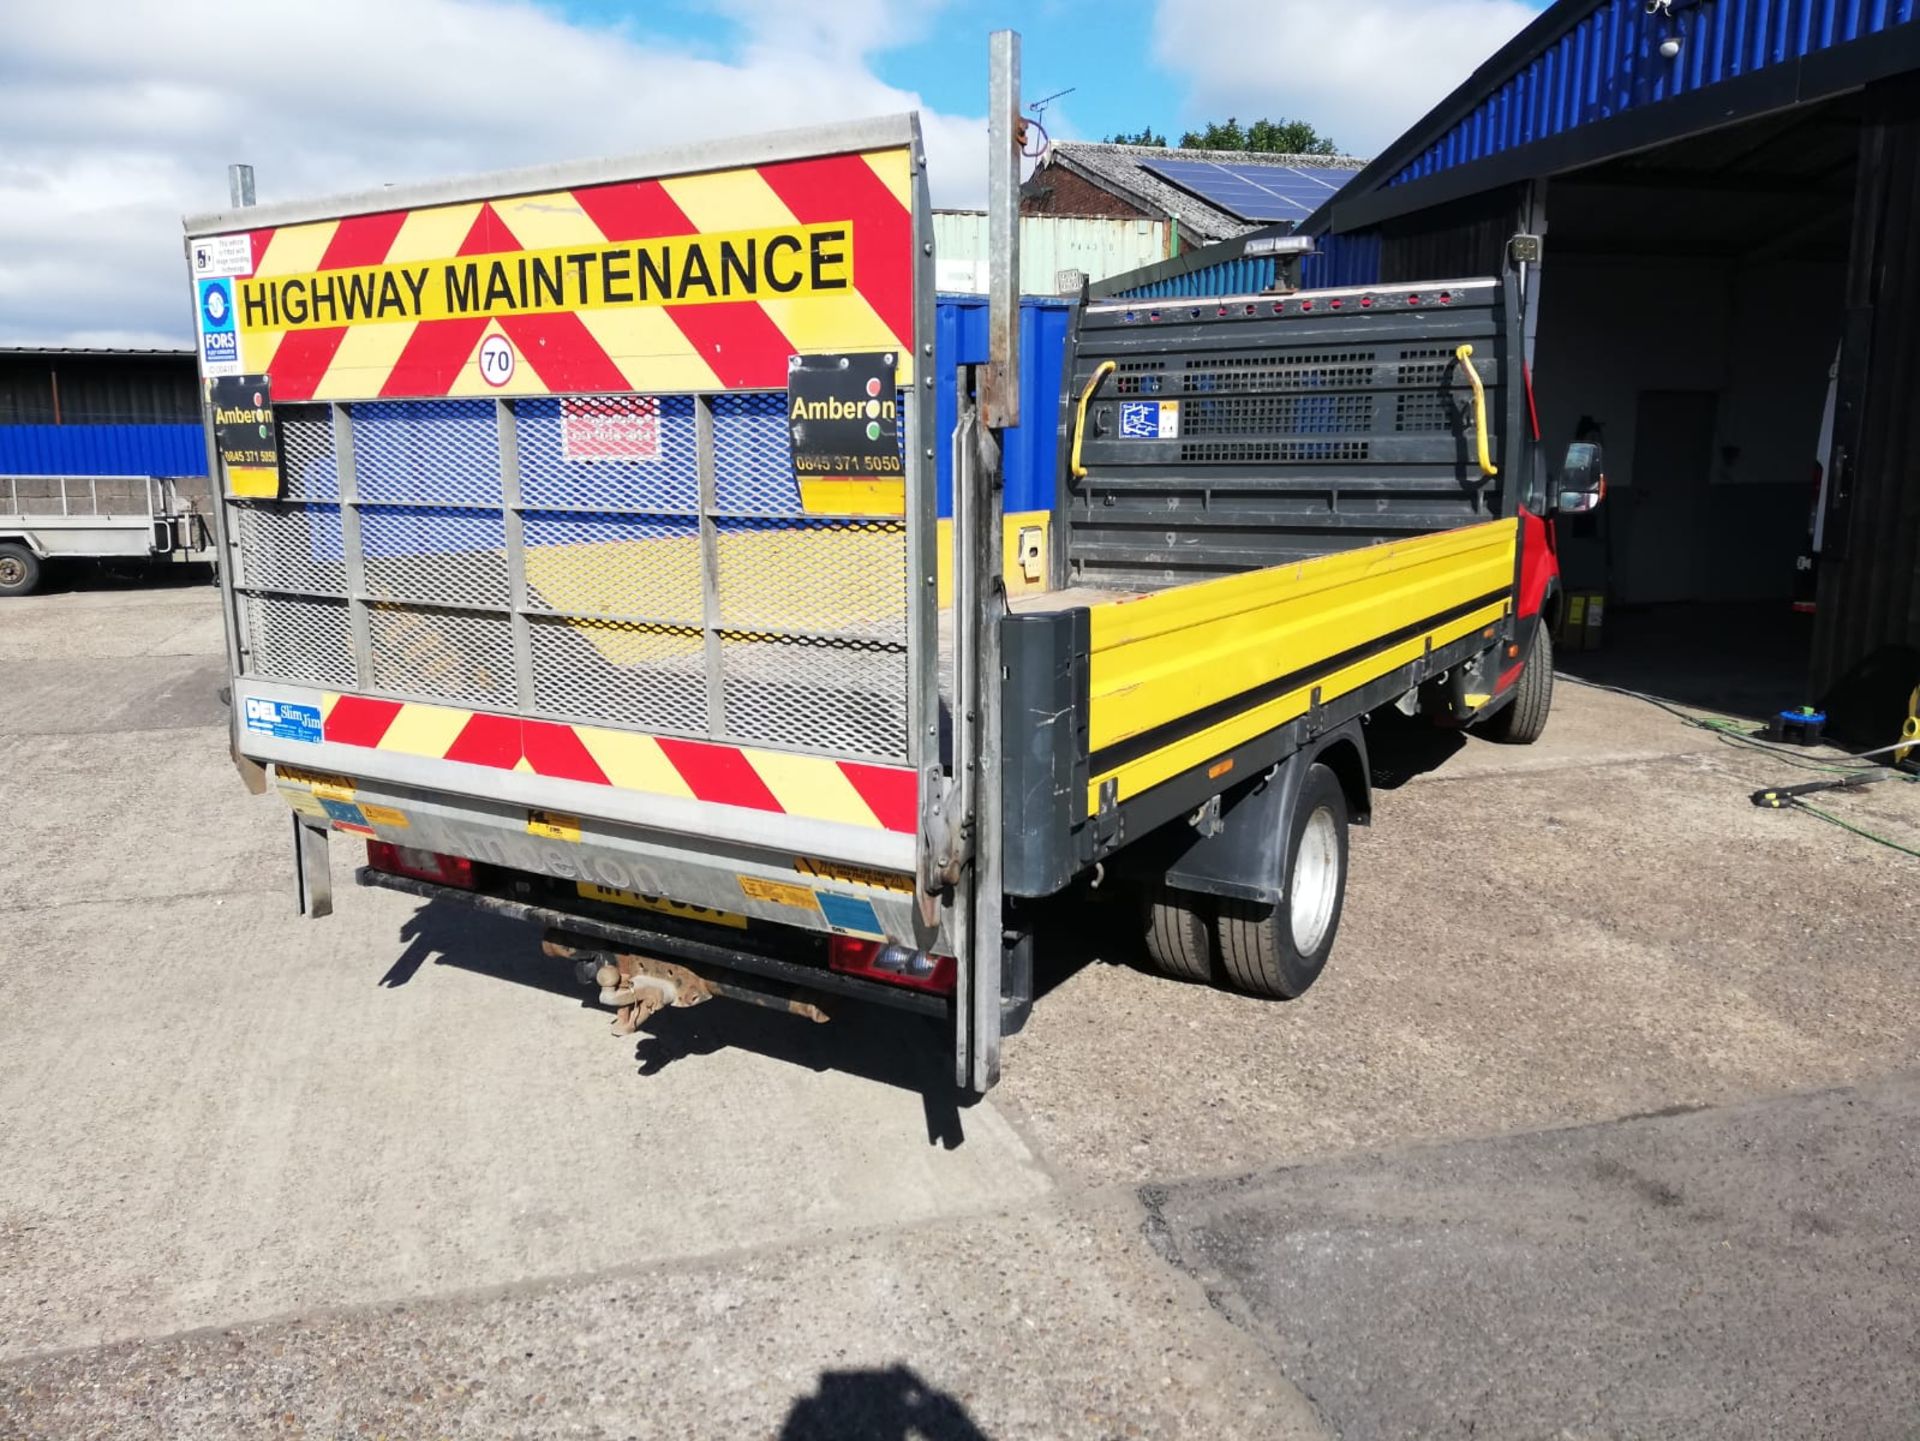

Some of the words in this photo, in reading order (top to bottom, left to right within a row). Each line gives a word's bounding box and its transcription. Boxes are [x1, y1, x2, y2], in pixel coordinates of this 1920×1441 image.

[243, 267, 430, 327] HIGHWAY
[444, 230, 848, 314] MAINTENANCE
[206, 332, 235, 348] FORS
[484, 351, 509, 372] 70
[215, 405, 273, 424] Amberon
[790, 396, 895, 419] Amberon
[796, 455, 831, 471] 0845
[834, 456, 859, 471] 371
[863, 456, 900, 471] 5050
[246, 699, 282, 723] DEL
[281, 704, 302, 721] Slim
[301, 713, 321, 729] Jim
